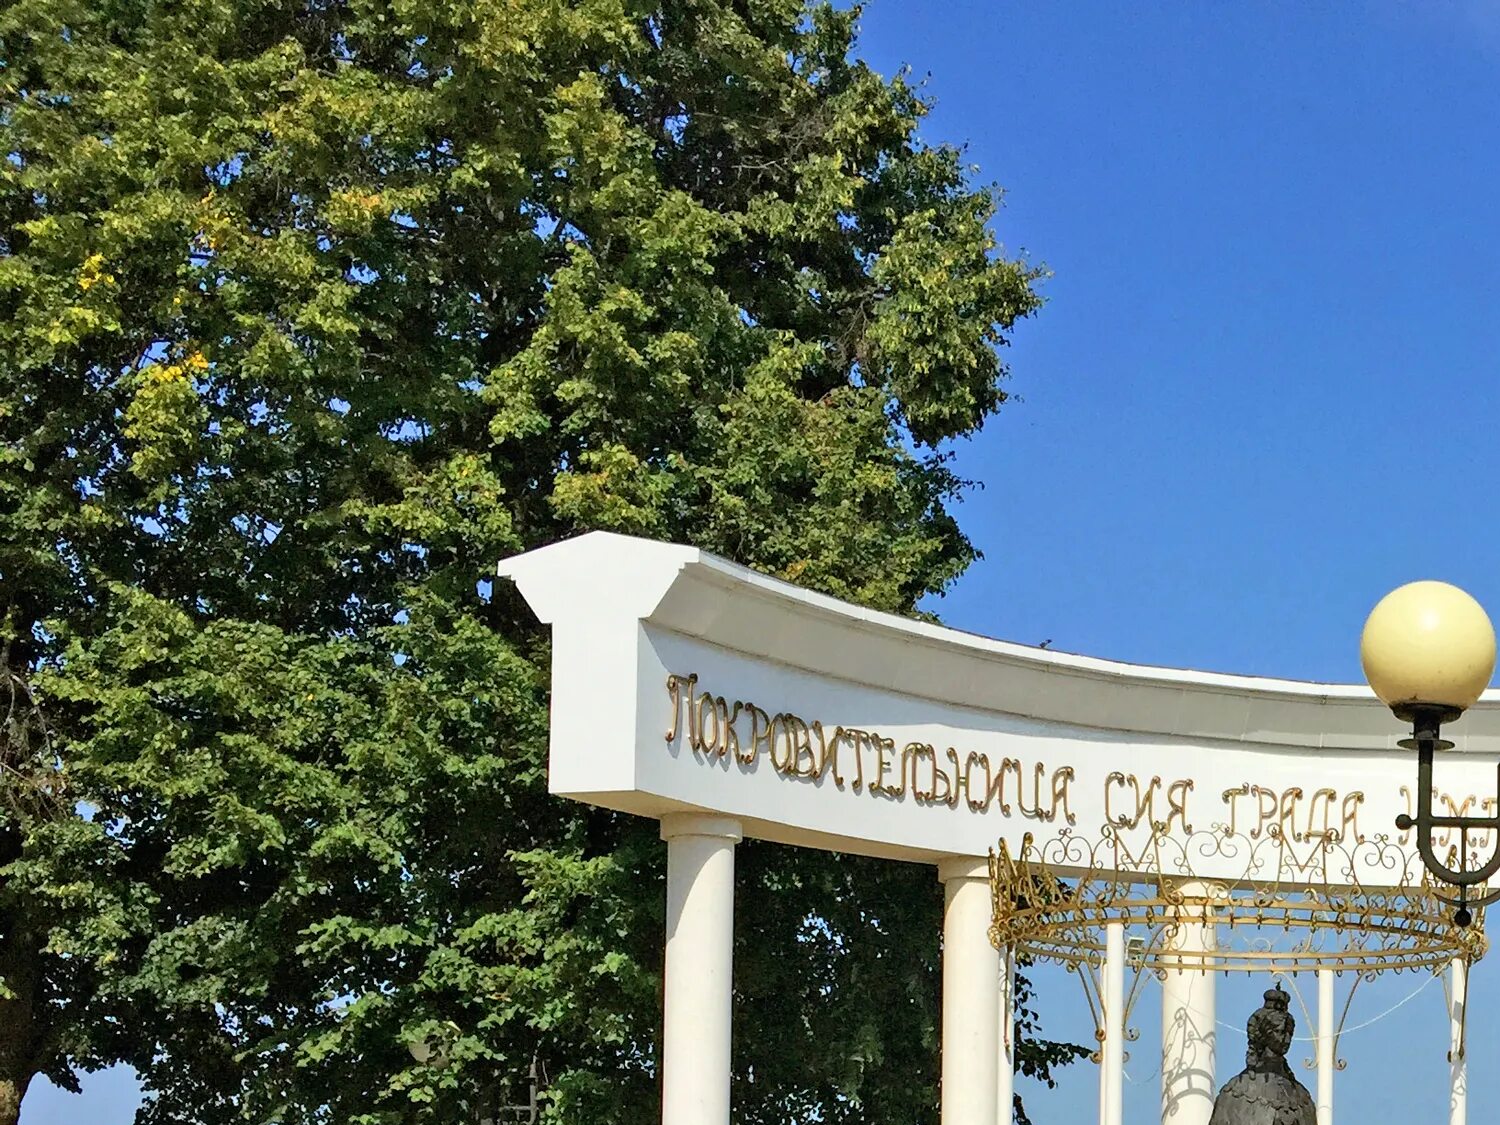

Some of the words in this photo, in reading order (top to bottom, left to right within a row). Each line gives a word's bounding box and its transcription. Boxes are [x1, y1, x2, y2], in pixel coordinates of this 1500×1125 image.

[665, 672, 1076, 825] ПОКРОВИТЕЛЬНИЦА
[1104, 771, 1195, 835] СИЯ
[1222, 782, 1365, 845] ГРАДА
